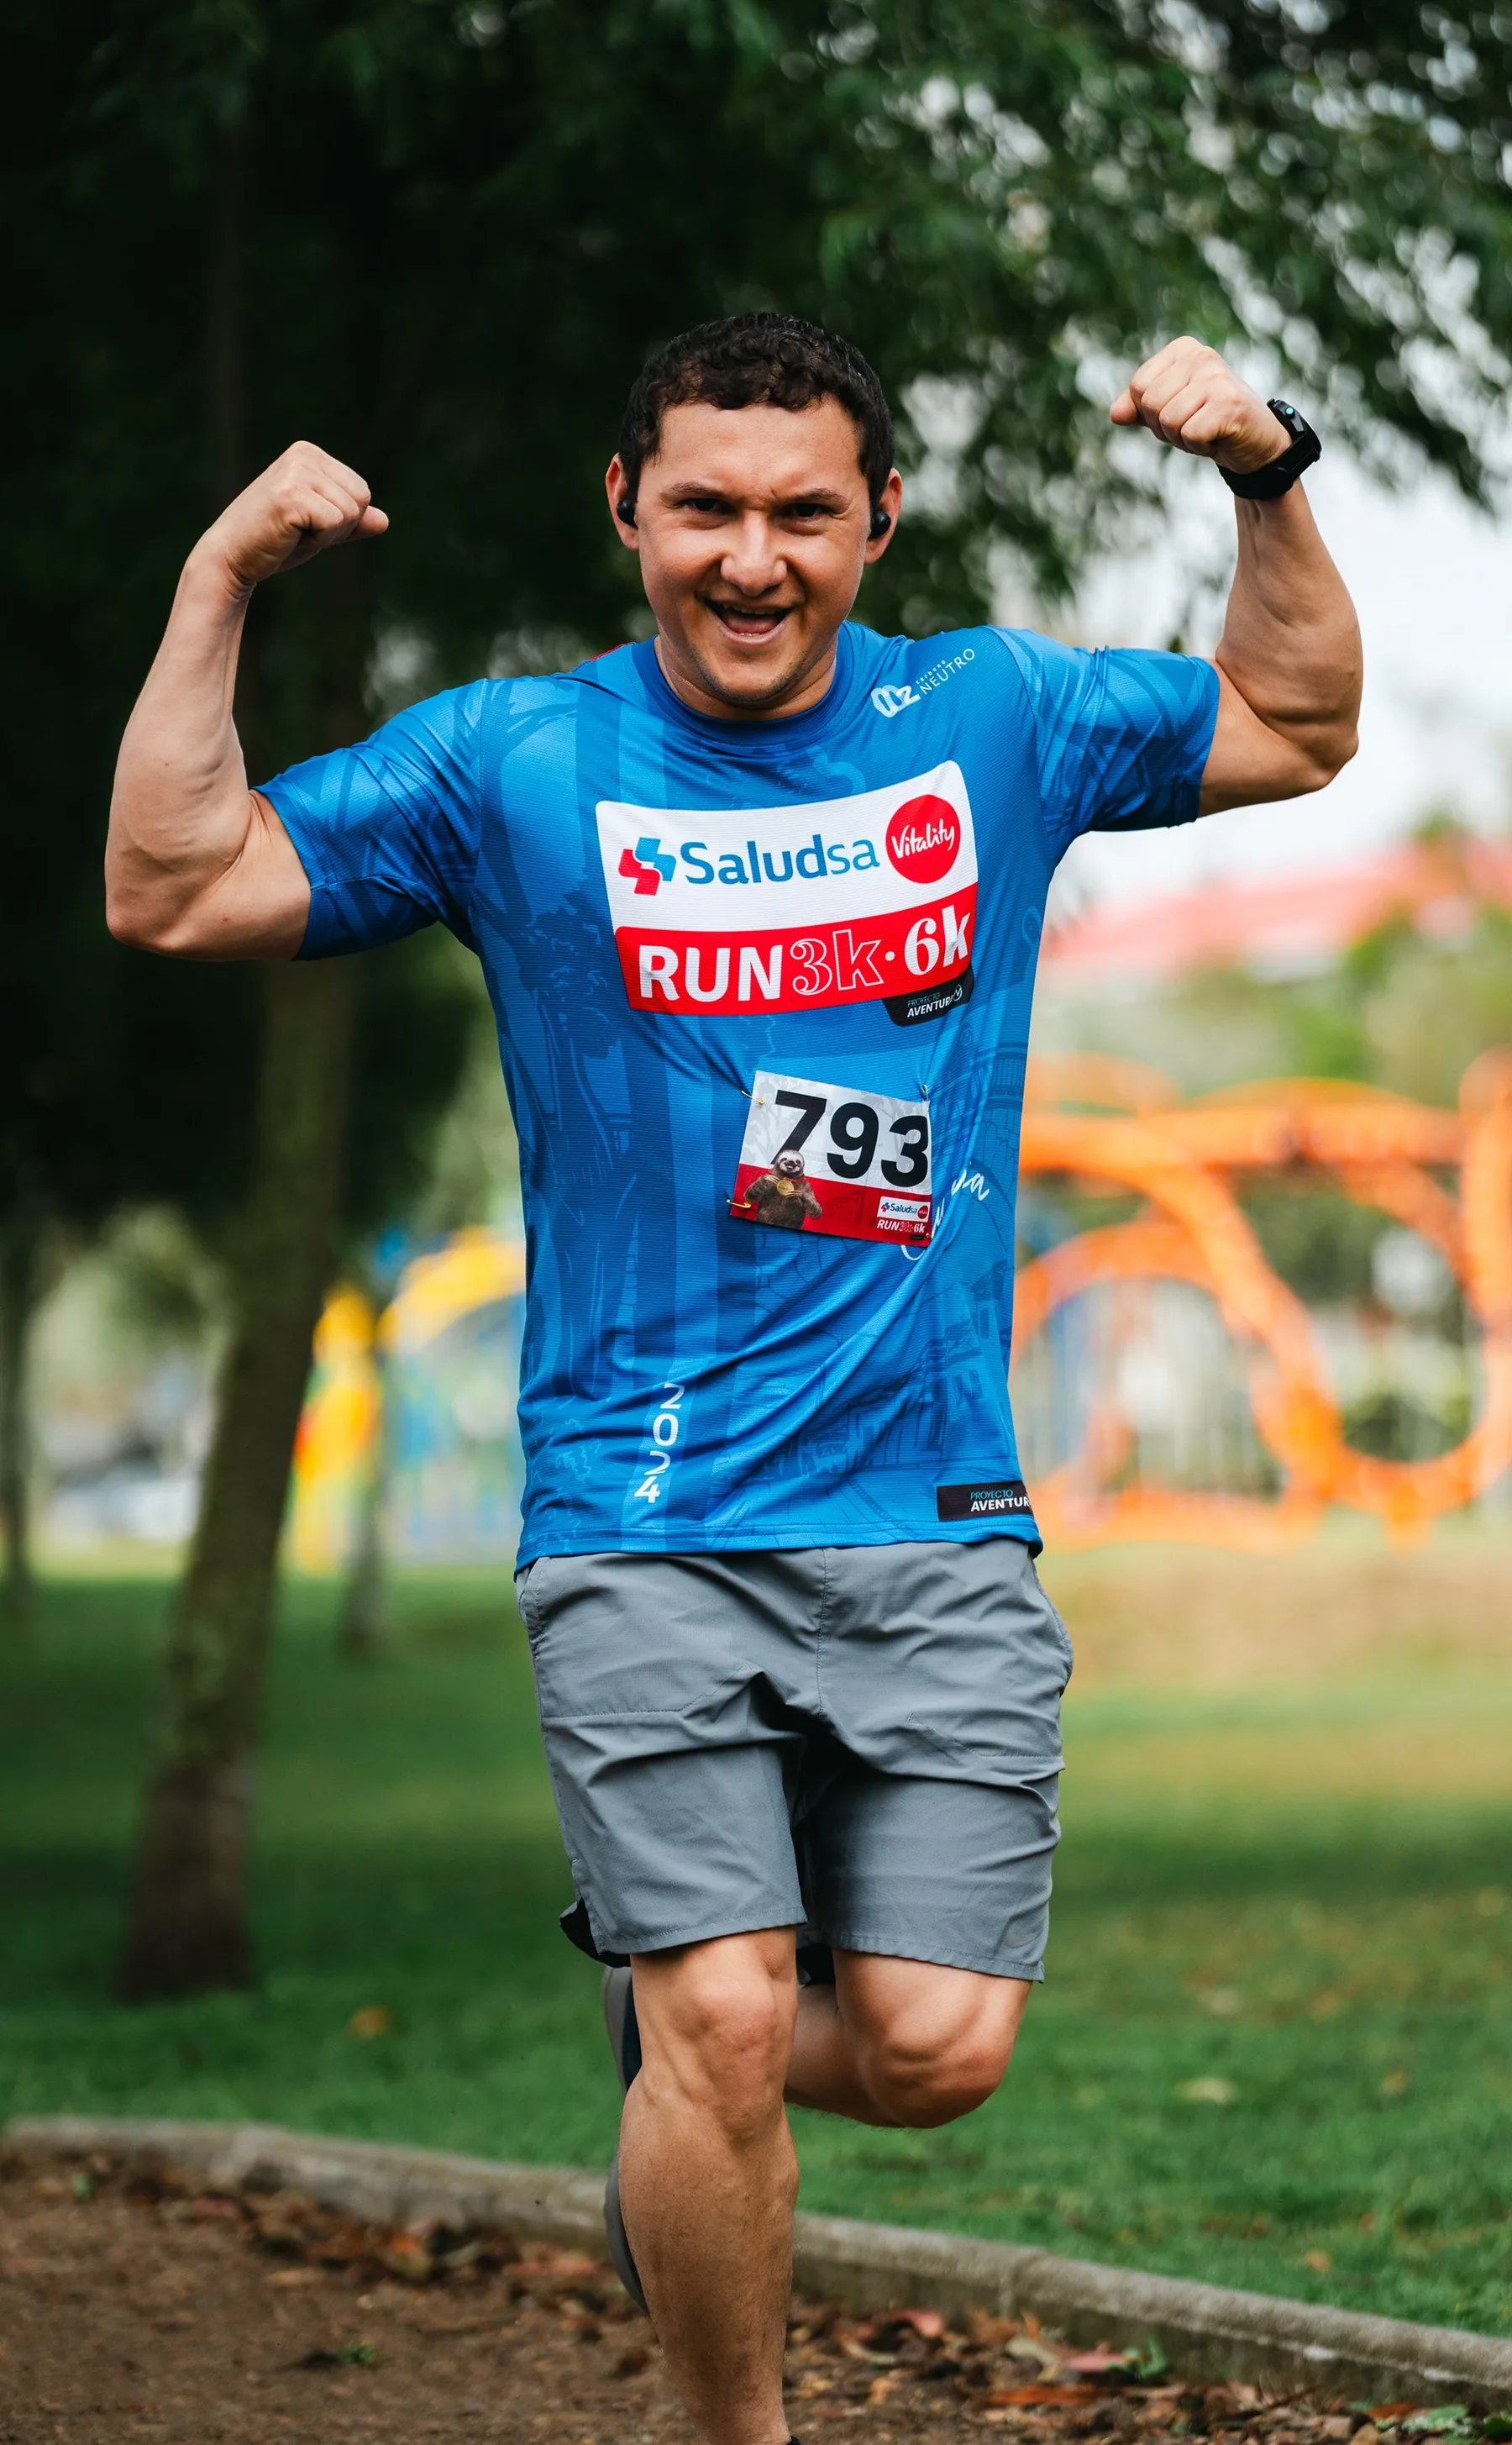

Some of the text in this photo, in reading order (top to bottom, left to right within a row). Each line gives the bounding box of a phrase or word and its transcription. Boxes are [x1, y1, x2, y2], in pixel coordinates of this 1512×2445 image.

[920, 648, 975, 695] NEUTRO
[680, 834, 880, 885] Saludsa
[891, 818, 955, 859] Vitality
[907, 992, 941, 1007] PROYECTO
[770, 1090, 928, 1188] 793
[890, 1202, 917, 1215] Saludsa
[634, 1383, 685, 1503] 2024
[970, 1489, 1013, 1500] PROYECTO
